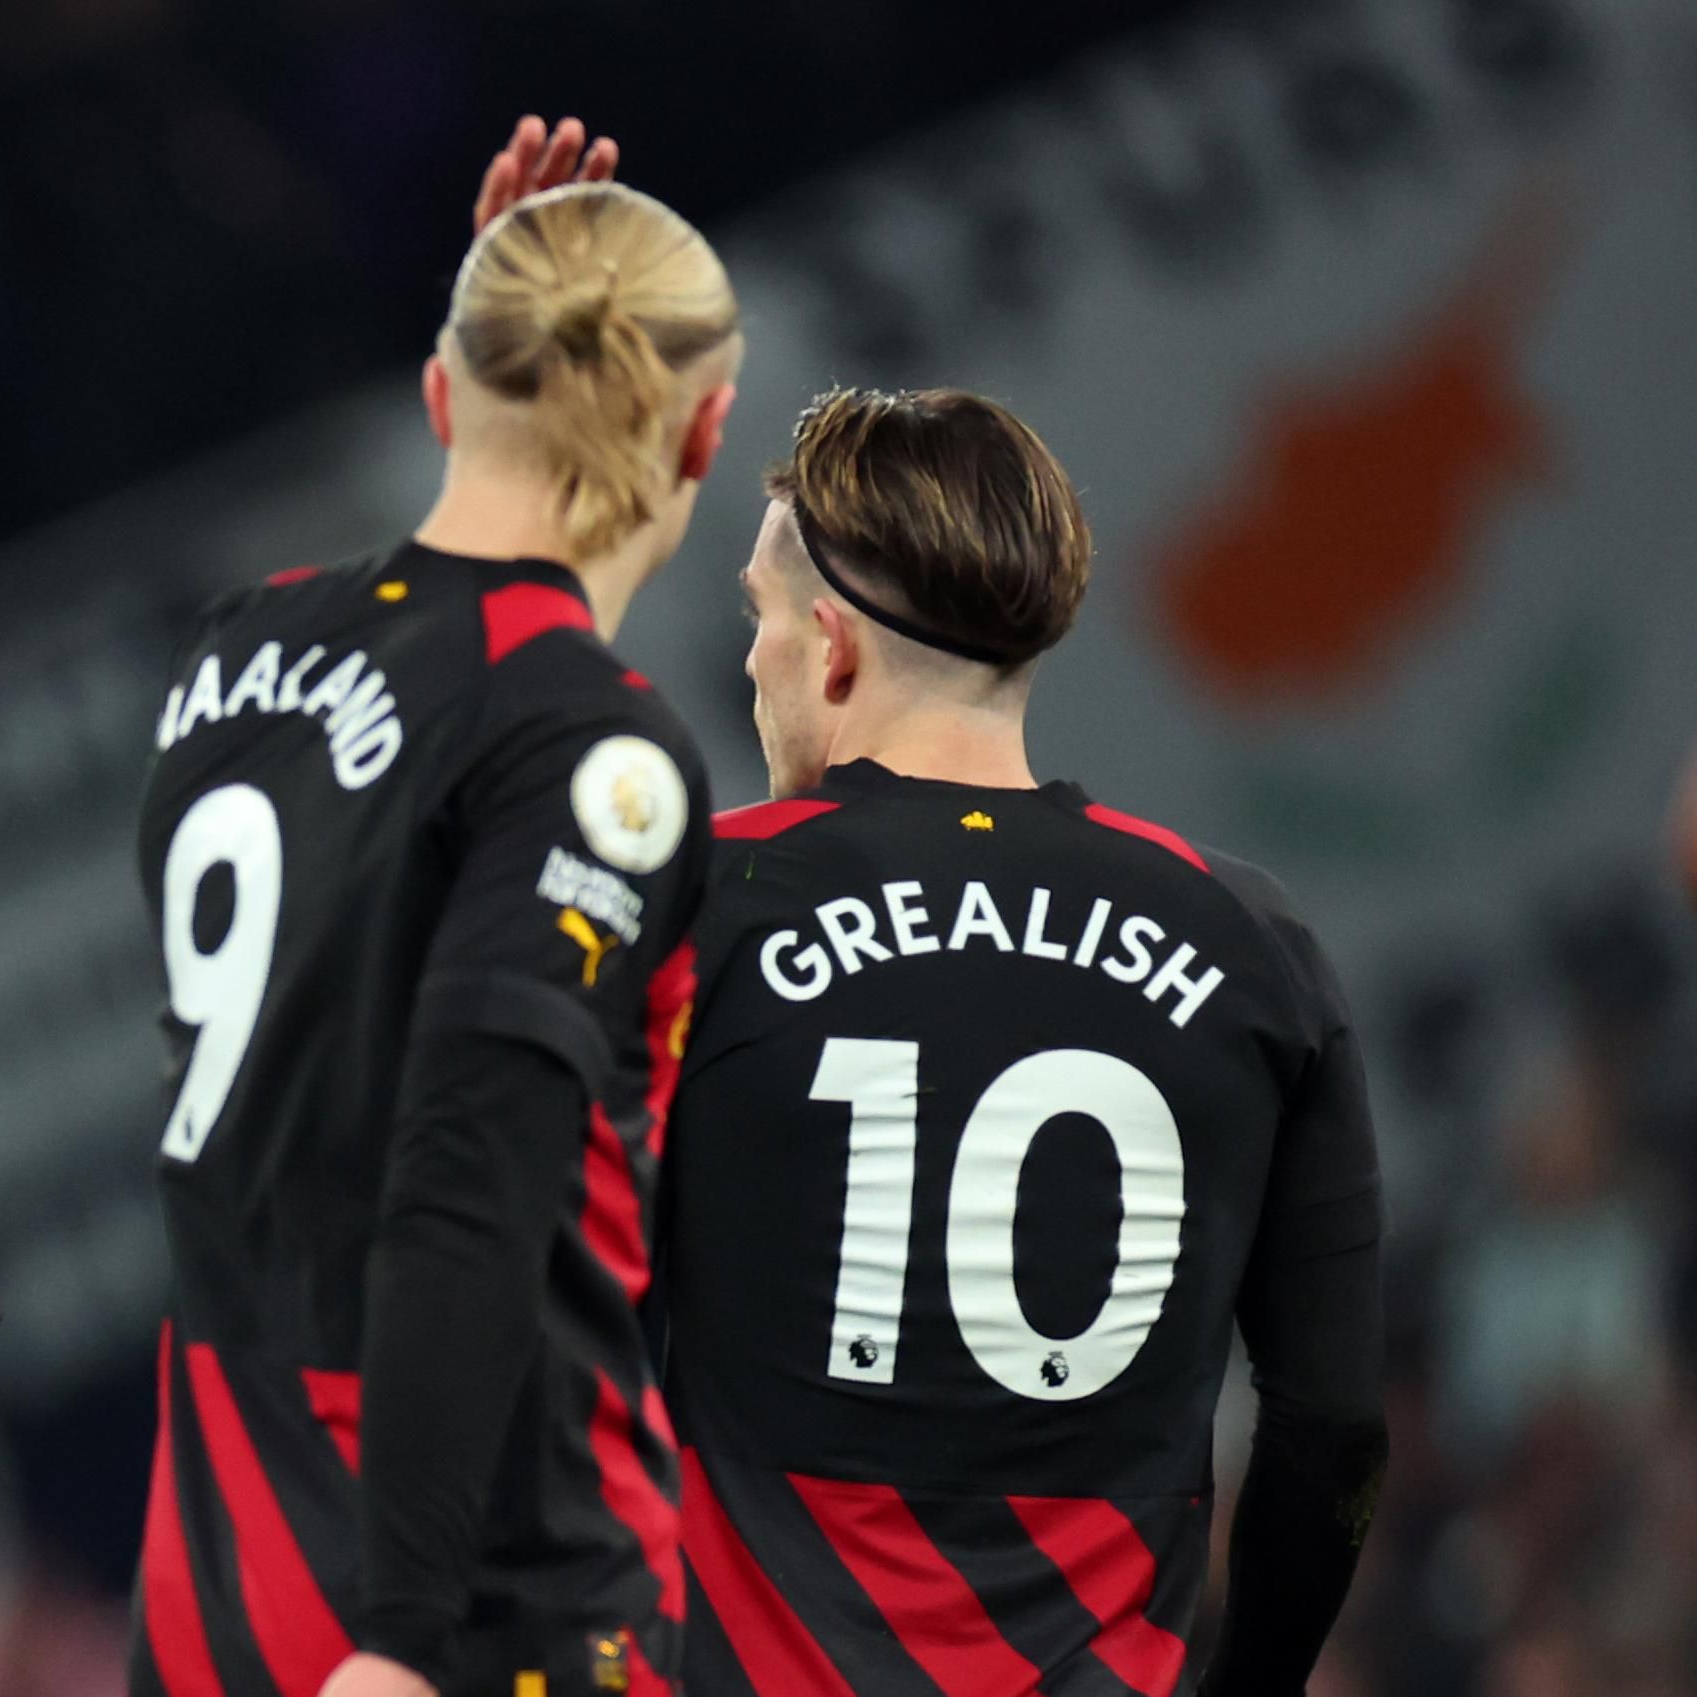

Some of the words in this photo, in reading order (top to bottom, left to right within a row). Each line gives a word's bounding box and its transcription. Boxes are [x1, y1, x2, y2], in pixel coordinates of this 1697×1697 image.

[162, 783, 283, 1163] 9
[760, 880, 1225, 1030] GREALISH
[807, 1037, 1188, 1402] 10
